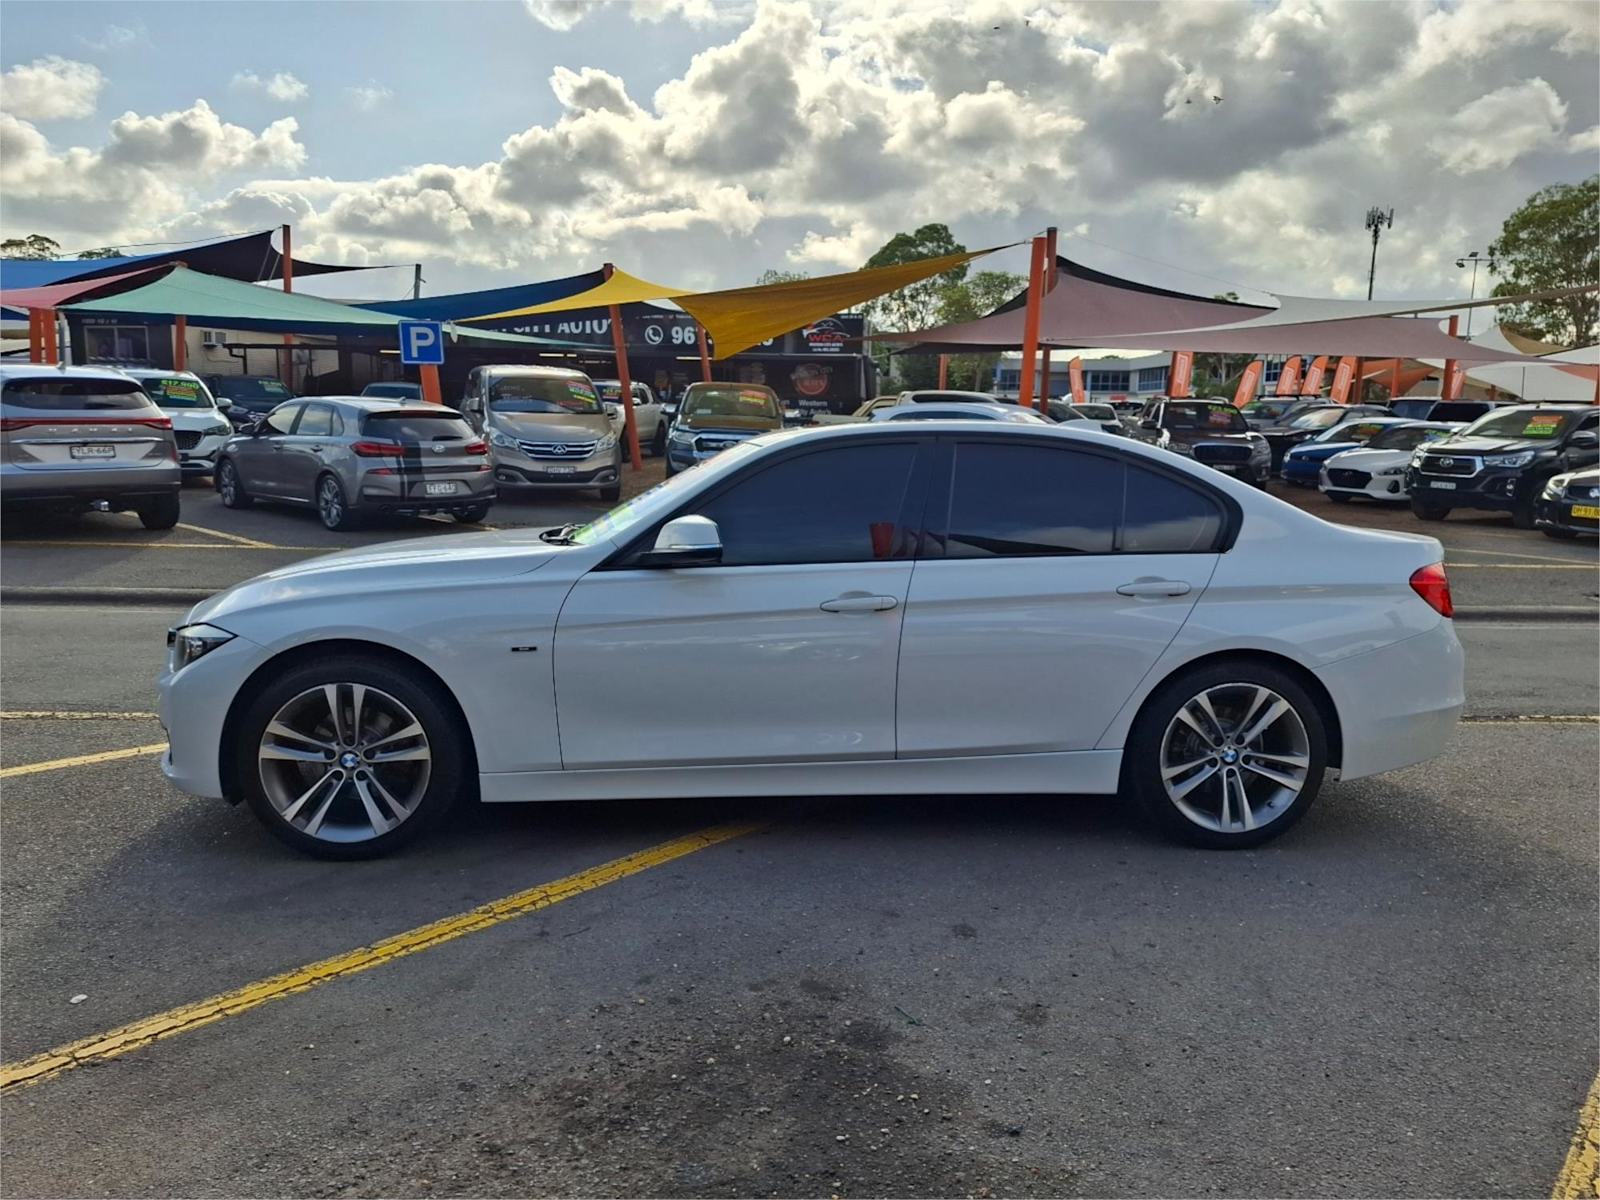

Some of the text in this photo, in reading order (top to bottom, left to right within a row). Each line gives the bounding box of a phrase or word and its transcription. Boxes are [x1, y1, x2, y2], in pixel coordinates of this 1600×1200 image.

[808, 334, 843, 342] WCA
[410, 327, 435, 358] P
[799, 399, 828, 407] Western
